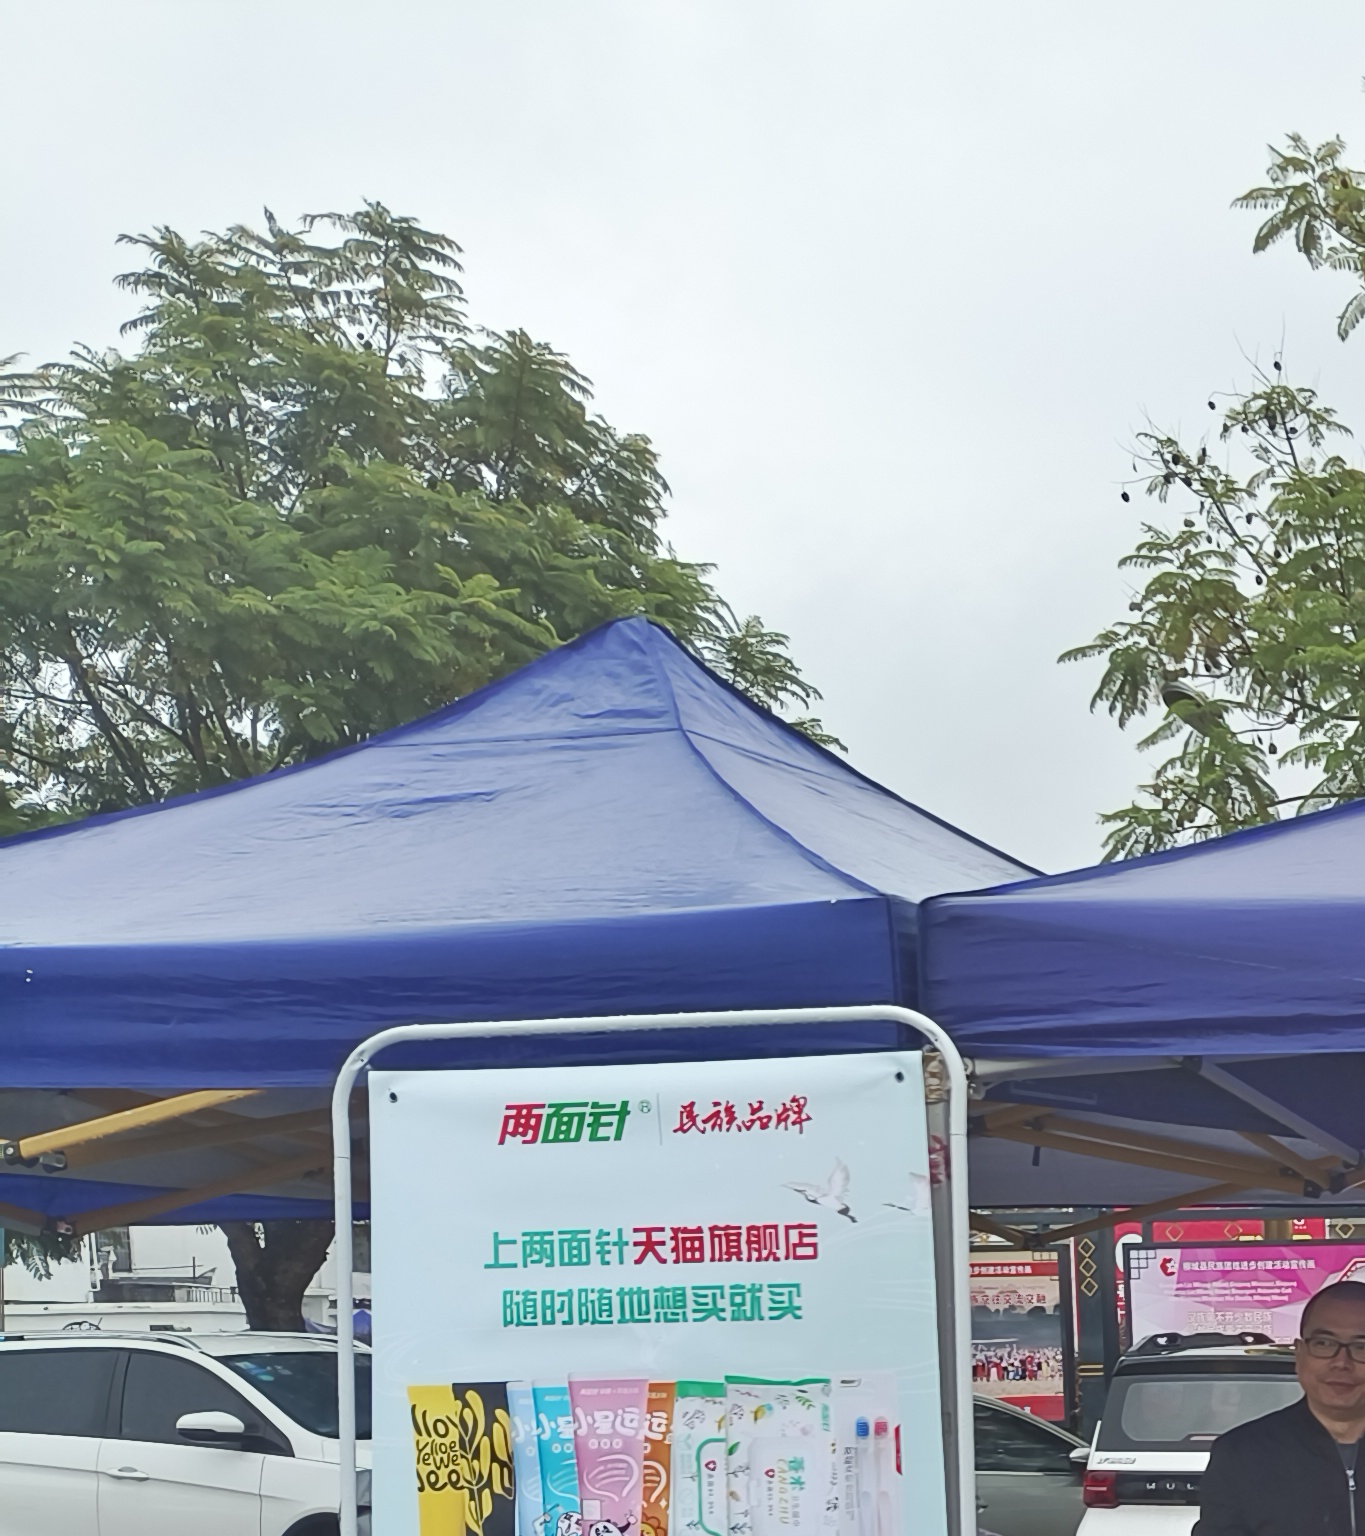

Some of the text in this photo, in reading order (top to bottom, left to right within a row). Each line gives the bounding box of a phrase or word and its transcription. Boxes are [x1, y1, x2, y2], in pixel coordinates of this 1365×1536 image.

[498, 1095, 813, 1145] 两面针 民族品牌
[484, 1223, 820, 1270] 上两面针天猫旗舰店
[502, 1283, 803, 1328] 随时随地想买就买
